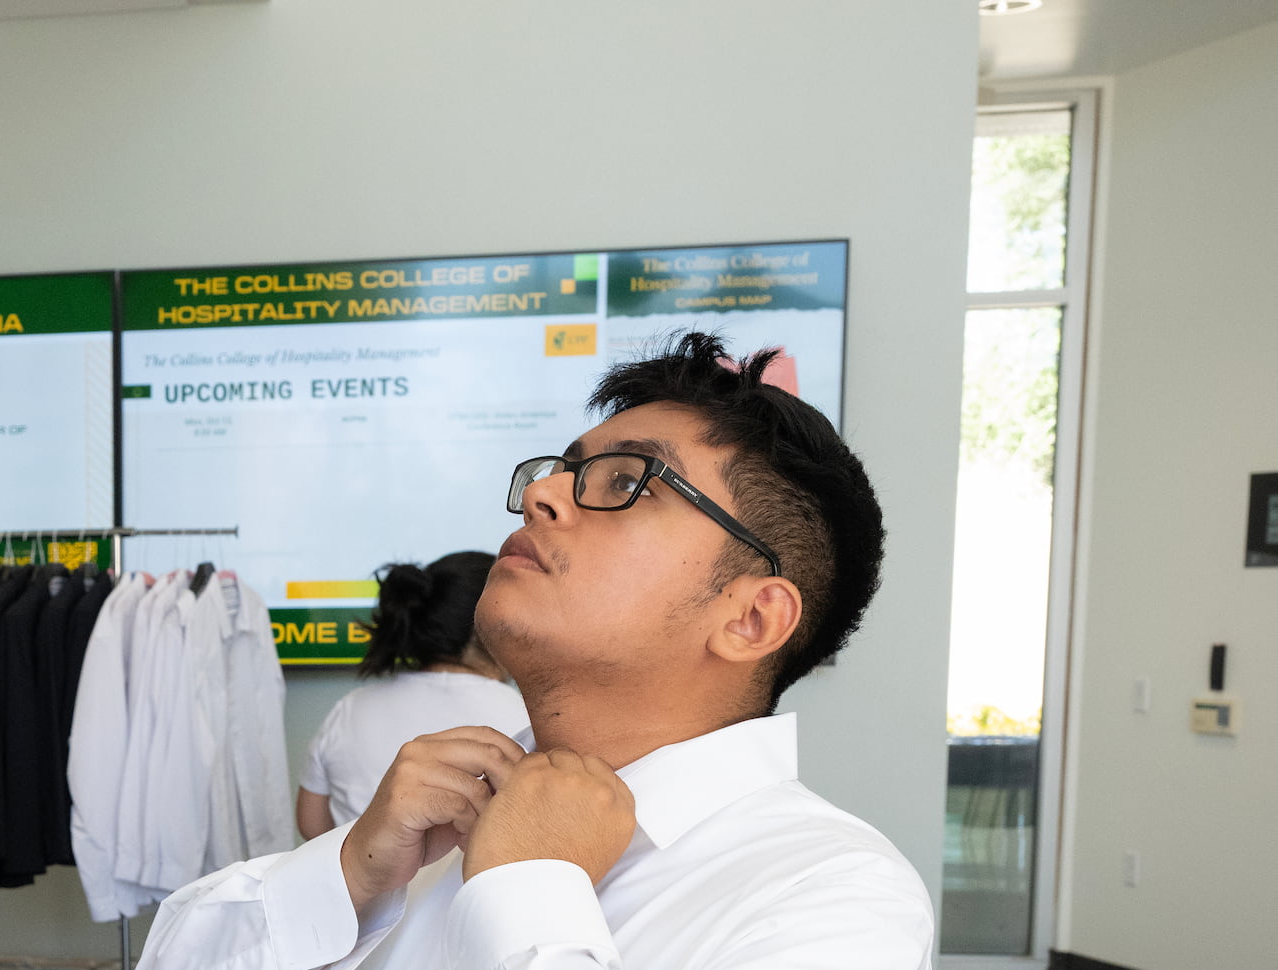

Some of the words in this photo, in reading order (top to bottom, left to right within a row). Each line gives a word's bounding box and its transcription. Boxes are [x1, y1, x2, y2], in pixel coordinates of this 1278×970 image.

[643, 257, 670, 274] The
[674, 255, 728, 272] Collins
[730, 253, 790, 271] College
[792, 251, 811, 267] of
[174, 276, 229, 296] THE
[234, 271, 354, 294] COLLINS
[359, 265, 486, 289] COLLEGE
[493, 264, 531, 283] OF
[630, 276, 712, 293] Hospitality
[717, 273, 818, 289] Management
[158, 300, 342, 325] HOSPITALITY
[348, 292, 548, 317] MANAGEMENT
[144, 354, 166, 367] The
[171, 353, 213, 366] Collins
[216, 352, 261, 367] College
[265, 350, 279, 366] of
[281, 348, 352, 365] Hospitality
[356, 346, 441, 361] Management
[164, 380, 293, 404] UPCOMING
[310, 376, 410, 399] EVENTS
[8, 424, 27, 436] OF
